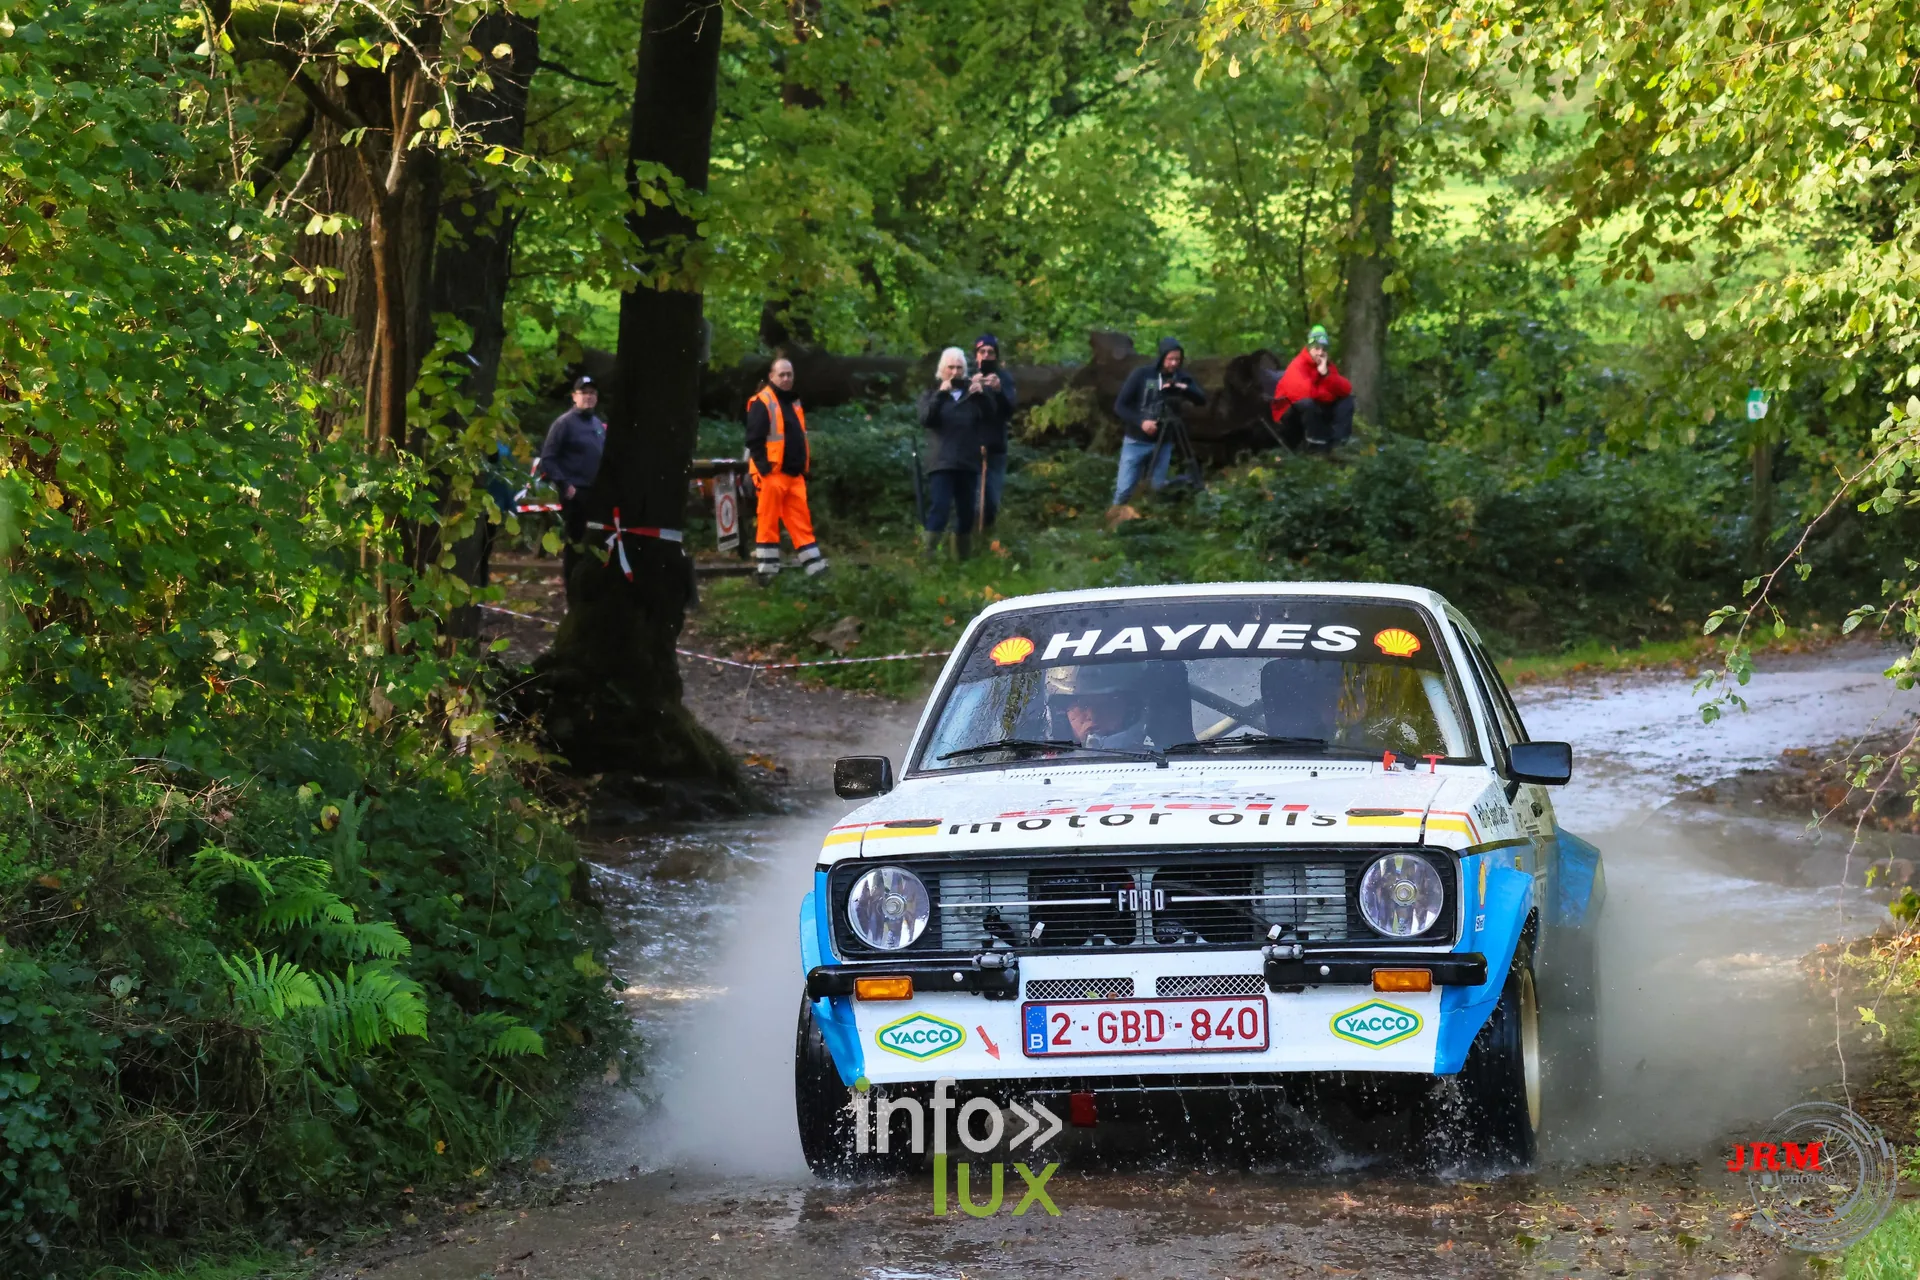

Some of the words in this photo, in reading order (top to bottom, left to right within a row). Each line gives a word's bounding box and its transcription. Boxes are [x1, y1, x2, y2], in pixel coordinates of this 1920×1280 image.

[1041, 623, 1361, 661] HAYNES
[949, 812, 1173, 835] motor
[1208, 811, 1338, 827] oils
[1117, 888, 1165, 912] FORD
[1051, 1006, 1259, 1046] 2-GBD-840
[1345, 1016, 1410, 1032] YACCO
[890, 1029, 953, 1044] YACCO
[1030, 1033, 1044, 1050] B
